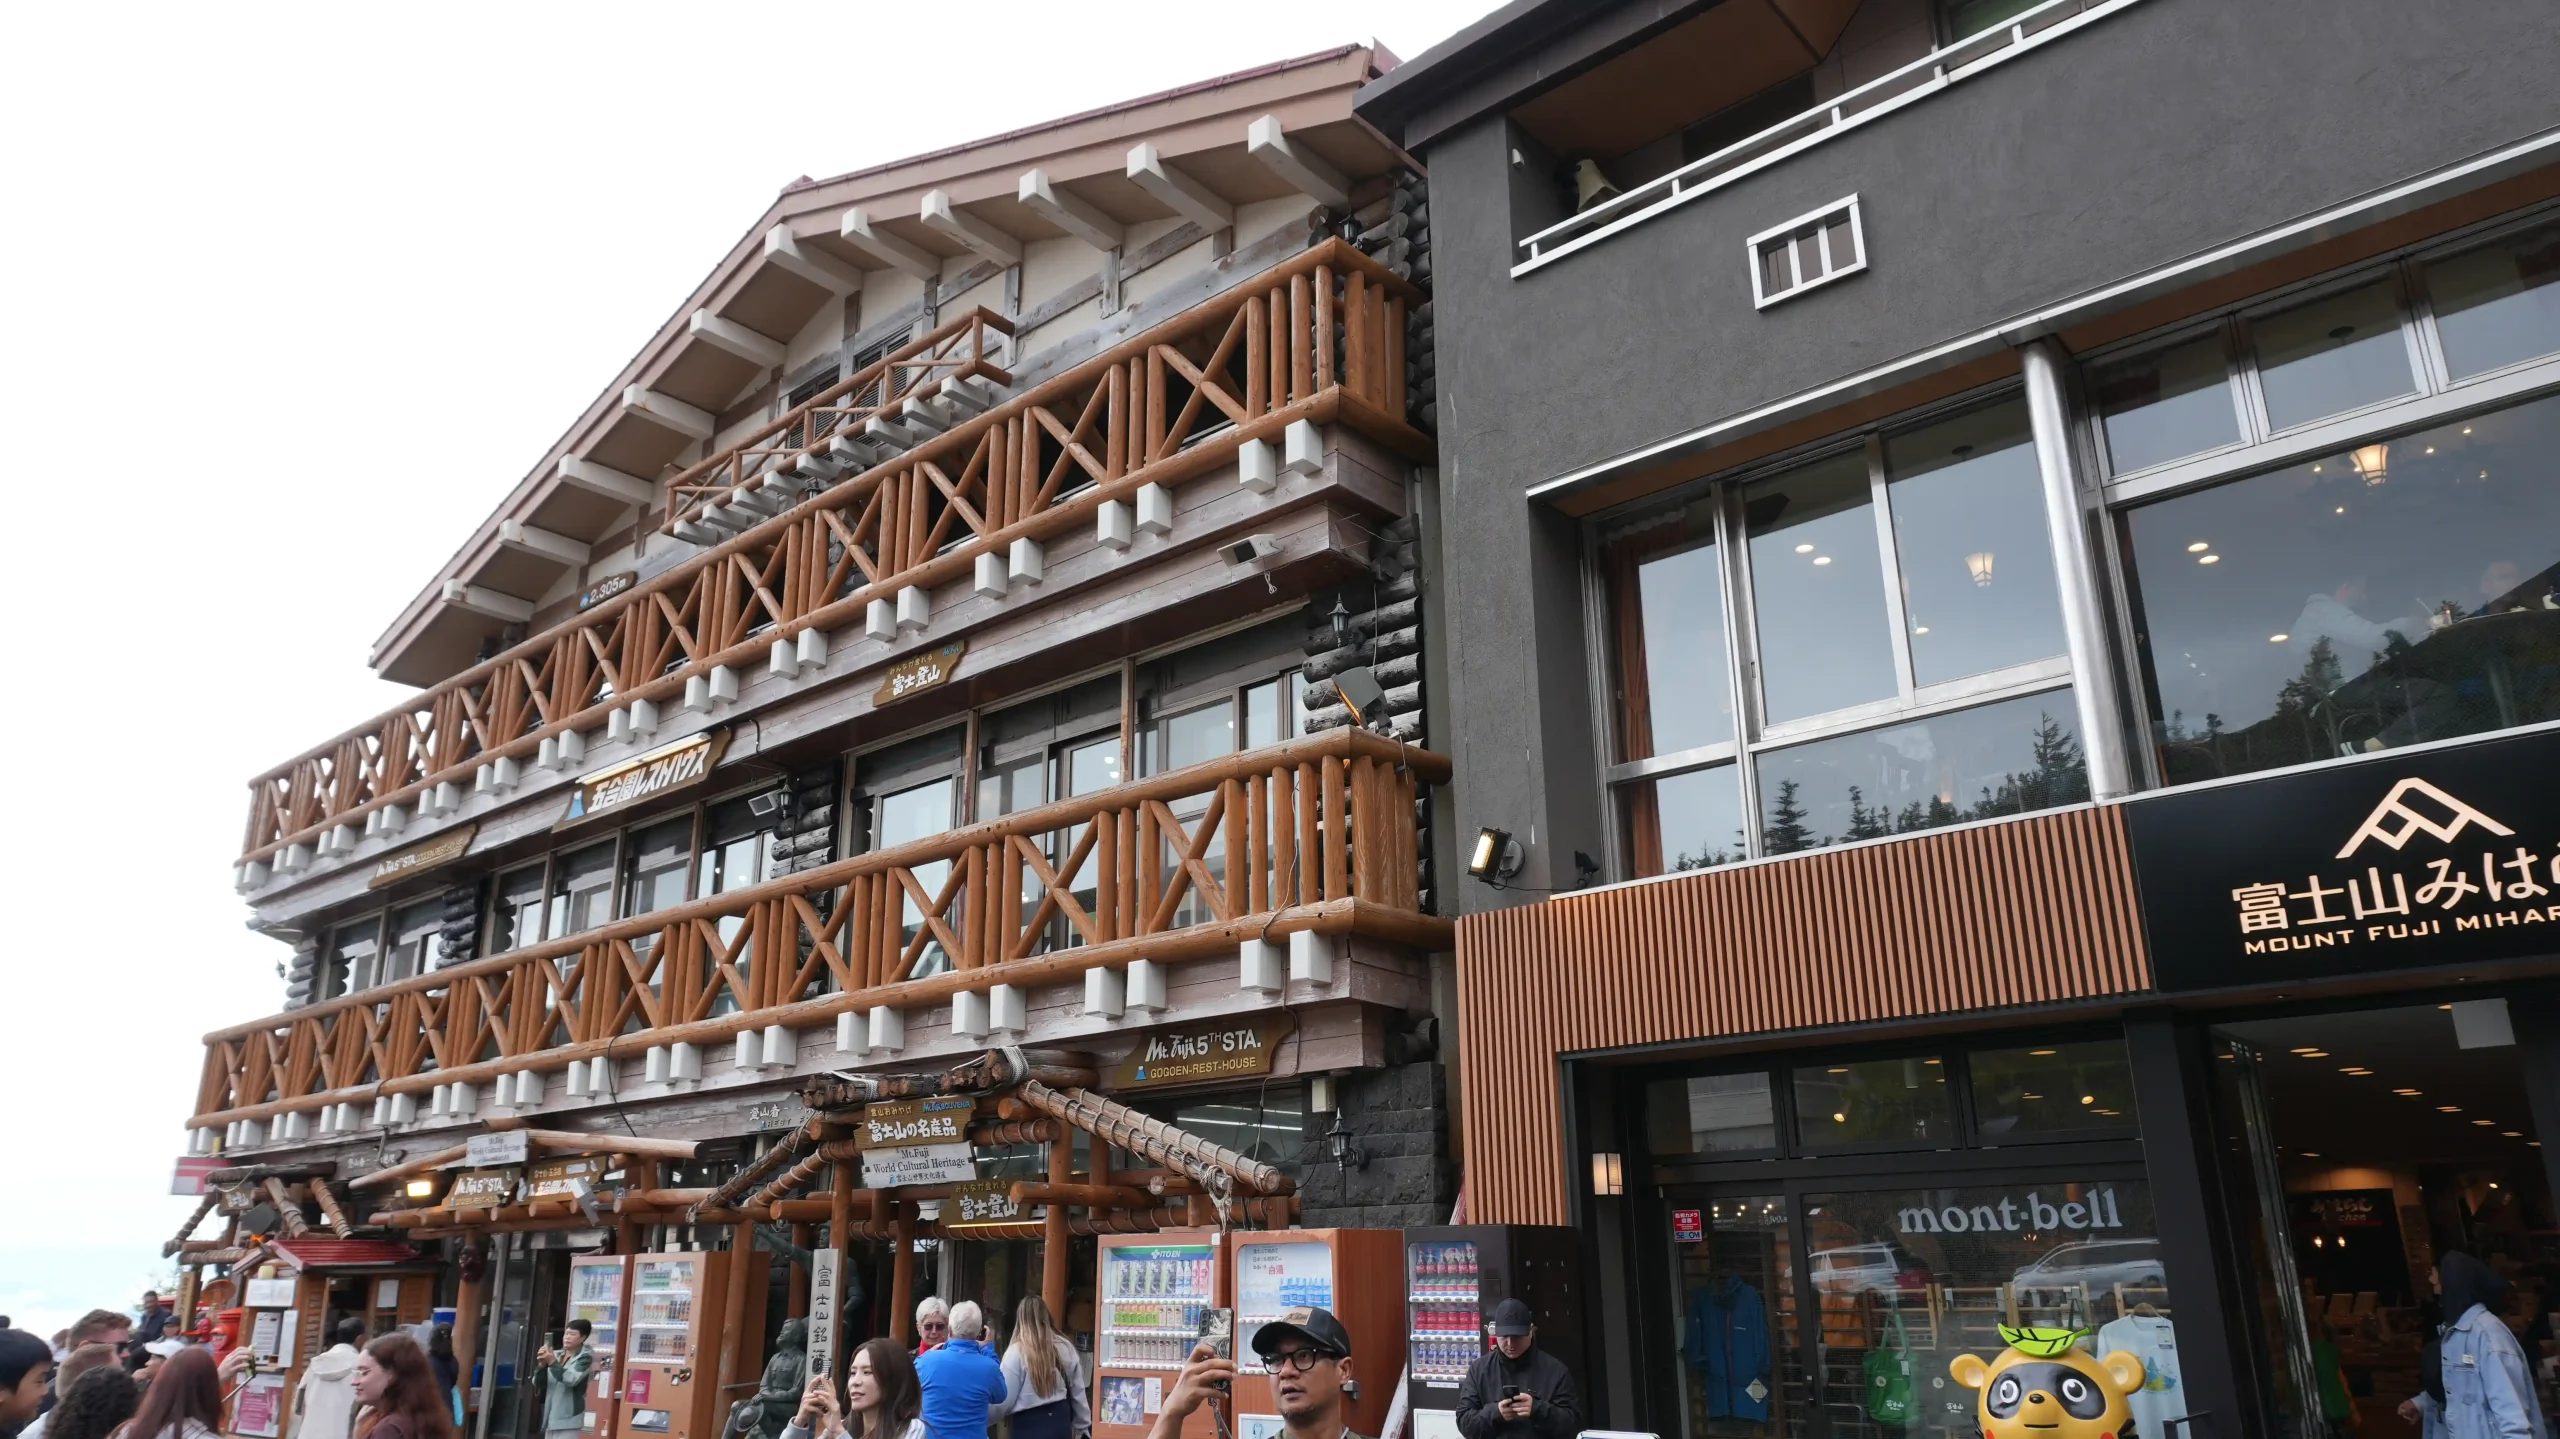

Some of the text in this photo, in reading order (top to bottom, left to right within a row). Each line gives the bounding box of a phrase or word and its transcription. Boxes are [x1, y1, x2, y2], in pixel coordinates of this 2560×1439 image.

[892, 664, 941, 696] 富士登山
[587, 742, 711, 813] 五合園レストハウス
[2232, 848, 2560, 934] 富士山みは
[2244, 929, 2354, 955] MOUNT
[2368, 920, 2441, 941] FUJI
[1222, 1028, 1262, 1052] STA.
[1150, 1056, 1256, 1079] GOGOEN-REST-HOUSE
[868, 1117, 957, 1142] 富士山の名産品
[873, 1156, 966, 1174] World Cultural Heritage
[901, 1147, 930, 1159] Mt.Fuji
[960, 1193, 1019, 1221] 富士登山
